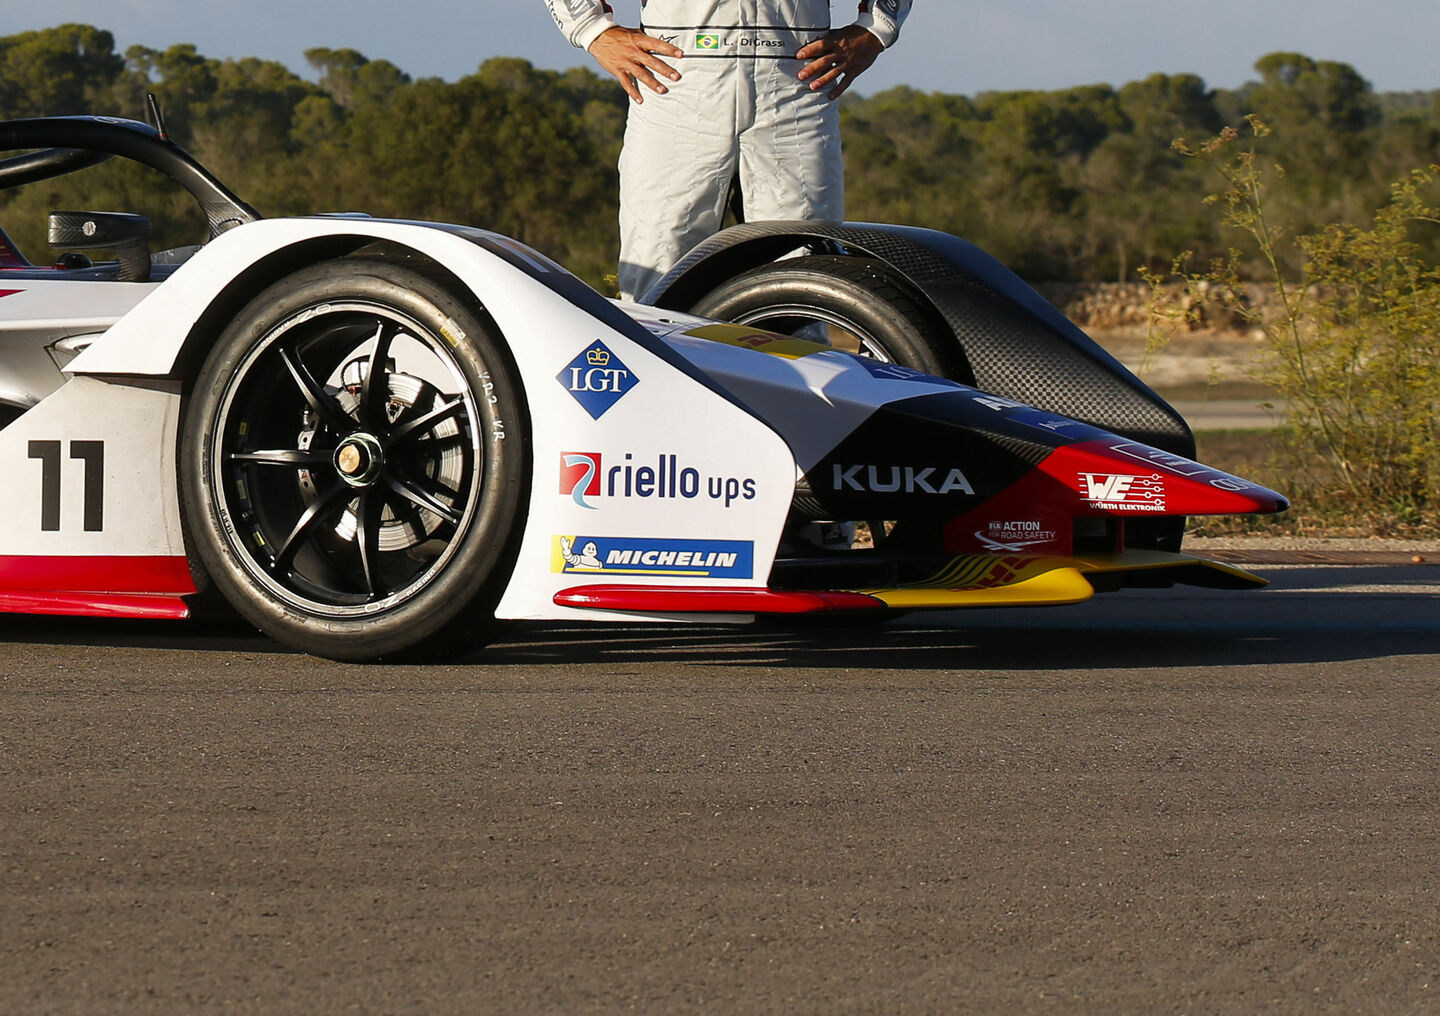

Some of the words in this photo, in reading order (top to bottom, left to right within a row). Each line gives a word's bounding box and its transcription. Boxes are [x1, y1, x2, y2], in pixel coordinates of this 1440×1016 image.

[568, 367, 629, 393] LGT
[28, 439, 105, 533] 11
[607, 453, 700, 499] riello
[708, 476, 757, 508] ups
[833, 463, 976, 496] KUKA
[1085, 473, 1135, 501] WE
[1089, 501, 1119, 510] WÜRTH
[1118, 502, 1167, 512] ELEKTRONIK
[1000, 531, 1024, 540] ROAD
[1024, 530, 1056, 540] SAFETY
[1003, 521, 1040, 531] ACTION
[605, 549, 739, 568] MICHELIN
[405, 568, 437, 597] RACING
